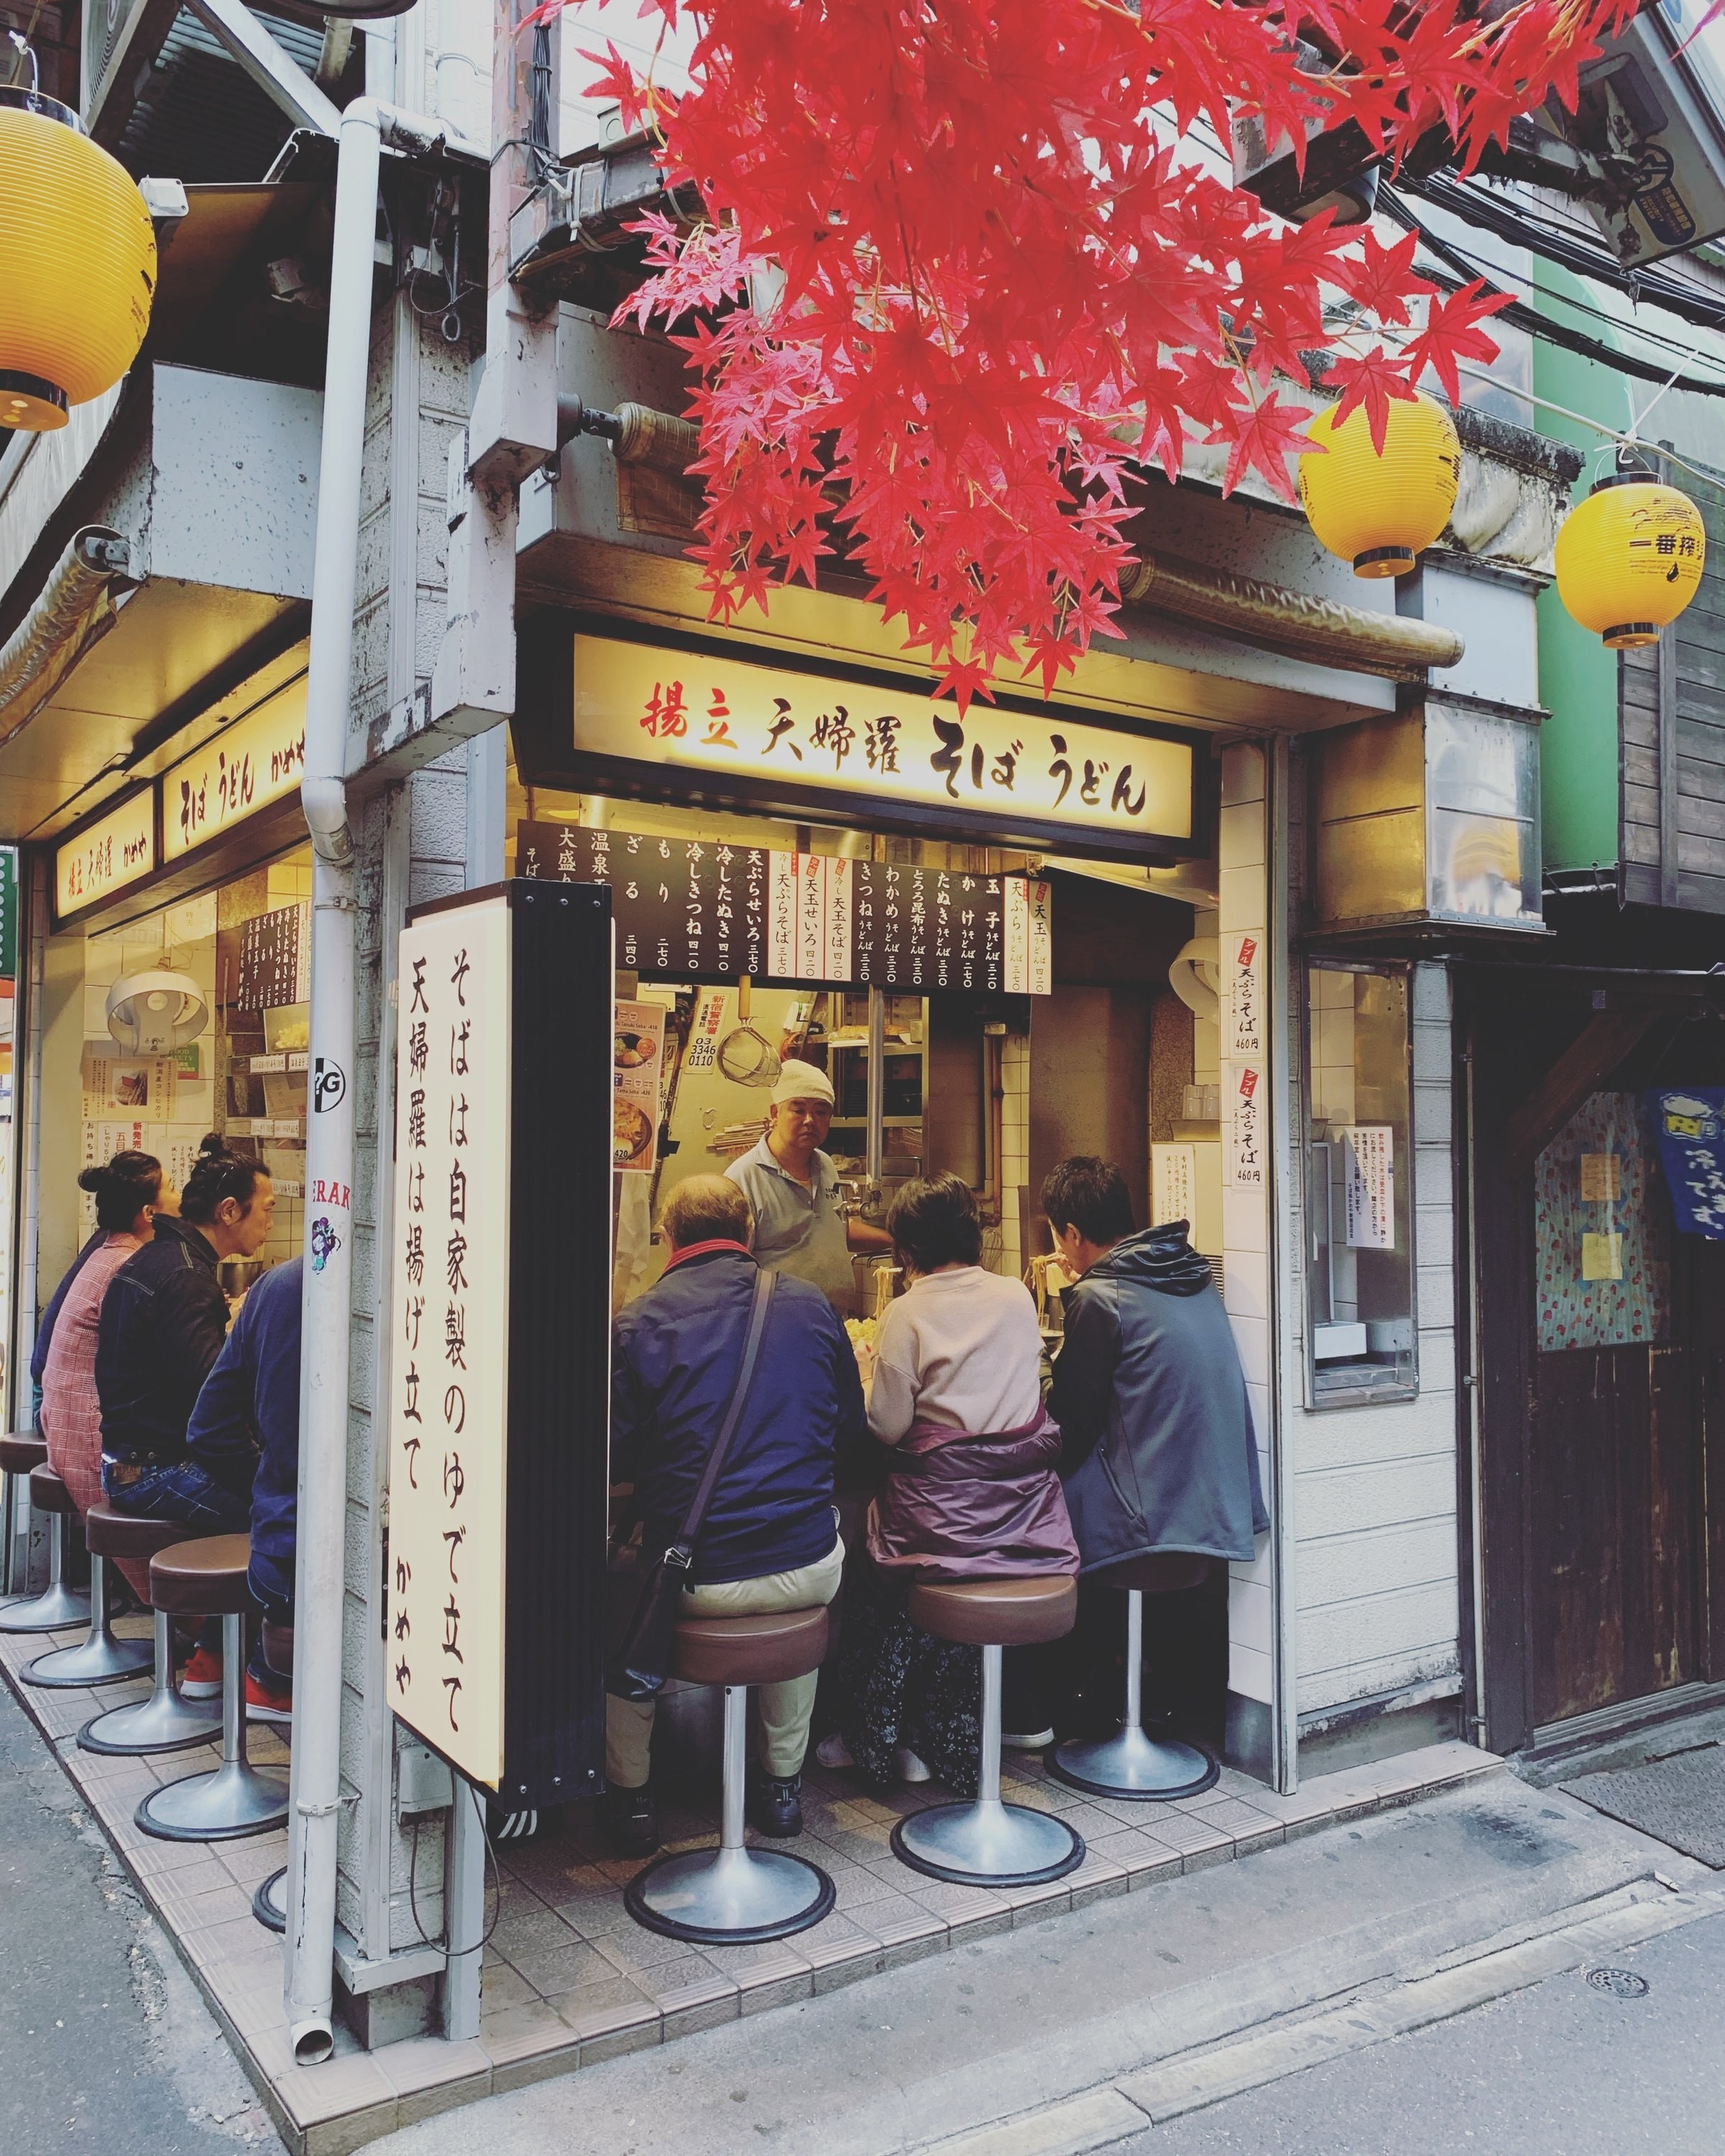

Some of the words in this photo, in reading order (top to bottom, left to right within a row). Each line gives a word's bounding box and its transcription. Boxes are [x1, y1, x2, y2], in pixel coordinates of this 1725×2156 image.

[640, 681, 738, 750] 揚立
[760, 697, 903, 775] 天婦羅
[929, 714, 1022, 800] そば
[1049, 734, 1146, 816] うどん
[181, 771, 208, 846] そば
[218, 752, 254, 823] うどん
[87, 834, 112, 890] 天婦羅
[124, 829, 147, 867] かめや
[625, 835, 643, 899] ざる
[658, 839, 671, 903] もり
[686, 842, 704, 935] 冷しきつね
[716, 846, 734, 938] 冷したぬき
[746, 850, 764, 941] 天ぷらせいろ
[804, 879, 819, 946] 天玉せいろ
[859, 862, 873, 917] きつね
[886, 866, 900, 919] わかめ
[910, 870, 926, 926] とろろ昆布
[937, 872, 951, 925] たぬき
[962, 876, 975, 926] かけ
[985, 879, 1000, 929] 玉子
[1011, 881, 1024, 931] 天ぷら
[1034, 904, 1046, 936] 天玉
[705, 995, 724, 1034] 新宿警察署
[689, 1055, 713, 1067] 0110
[691, 1046, 716, 1055] 3346
[1236, 1038, 1259, 1049] 460円
[132, 1122, 142, 1149] 新発売
[1238, 1170, 1260, 1182] 460円
[403, 956, 430, 1490] 天婦羅は揚げ立て
[442, 948, 471, 1732] そばは自家製のゆで立て
[395, 1555, 412, 1695] かめや
